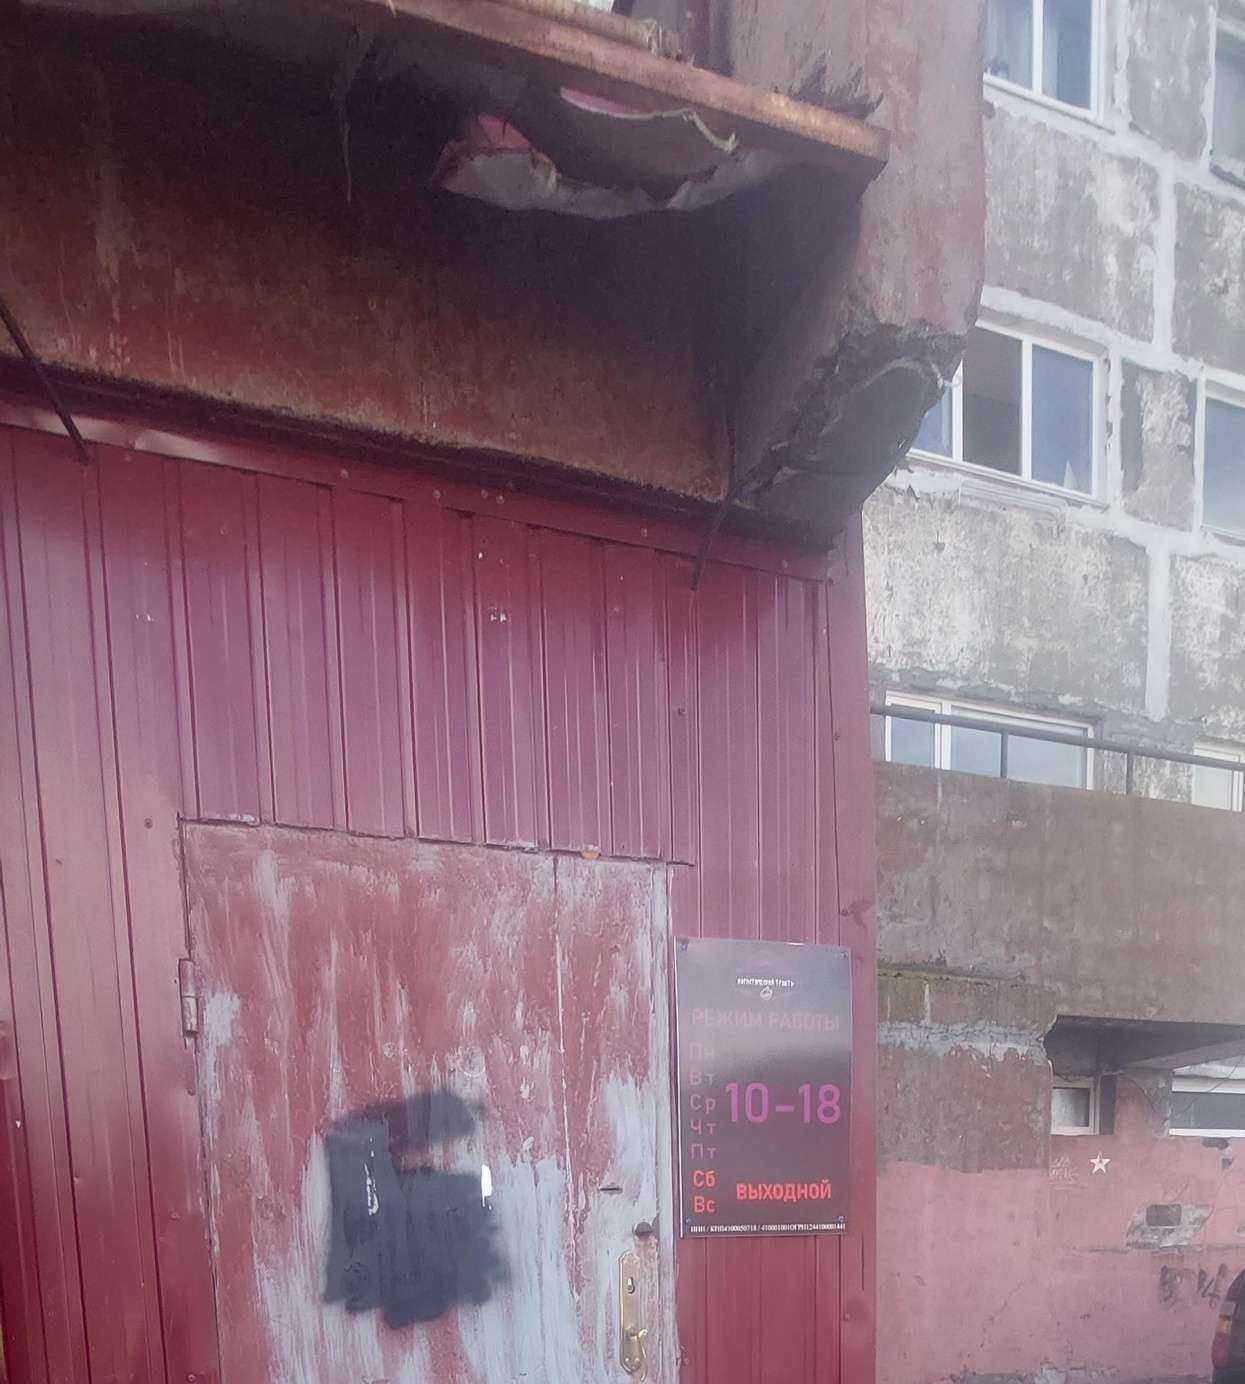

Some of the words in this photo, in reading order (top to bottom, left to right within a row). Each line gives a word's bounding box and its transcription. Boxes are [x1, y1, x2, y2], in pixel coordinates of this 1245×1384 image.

[691, 1008, 762, 1026] РЕЖИМ
[768, 1011, 840, 1031] РАБОТЫ
[689, 1072, 715, 1086] Вт
[690, 1093, 716, 1114] Ср
[725, 1082, 841, 1124] 10-18
[690, 1117, 716, 1135] Чт
[691, 1143, 716, 1160] Пт
[693, 1169, 716, 1188] Сб
[736, 1179, 832, 1202] ВЫХОДНОЙ
[694, 1195, 716, 1213] Вс
